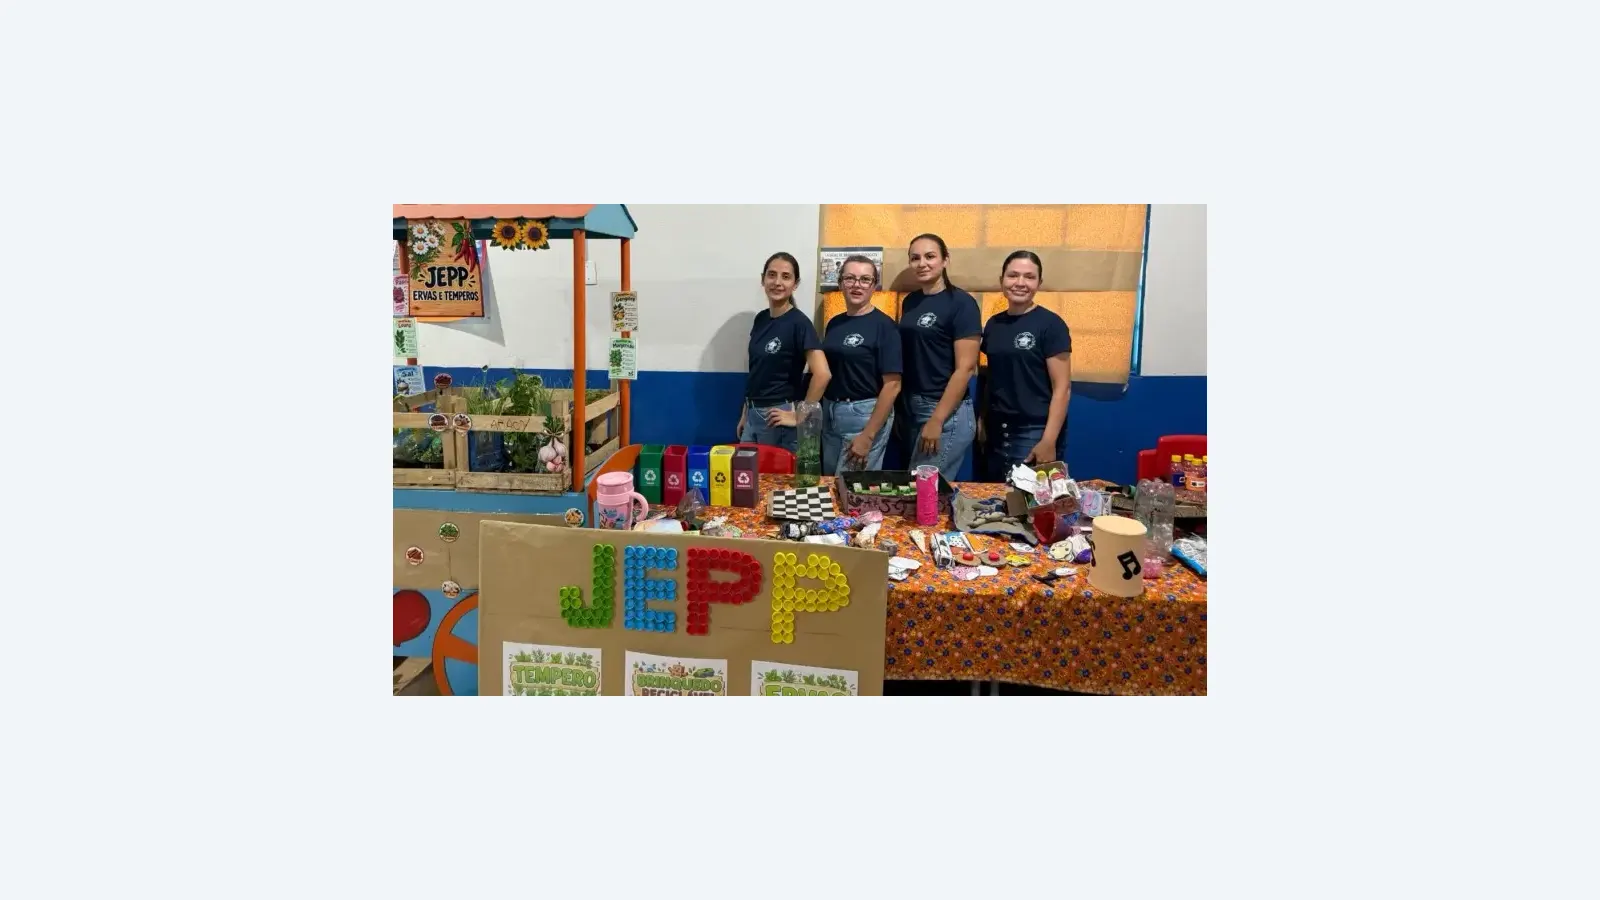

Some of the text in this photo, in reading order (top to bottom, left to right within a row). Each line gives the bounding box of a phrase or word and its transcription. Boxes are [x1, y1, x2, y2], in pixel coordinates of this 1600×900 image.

[425, 266, 469, 288] JEPP
[413, 290, 479, 302] ERVAS E TEMPEROS
[559, 543, 850, 644] JEPP
[512, 665, 597, 688] TEMPERO
[636, 673, 722, 692] BRINQUEDO
